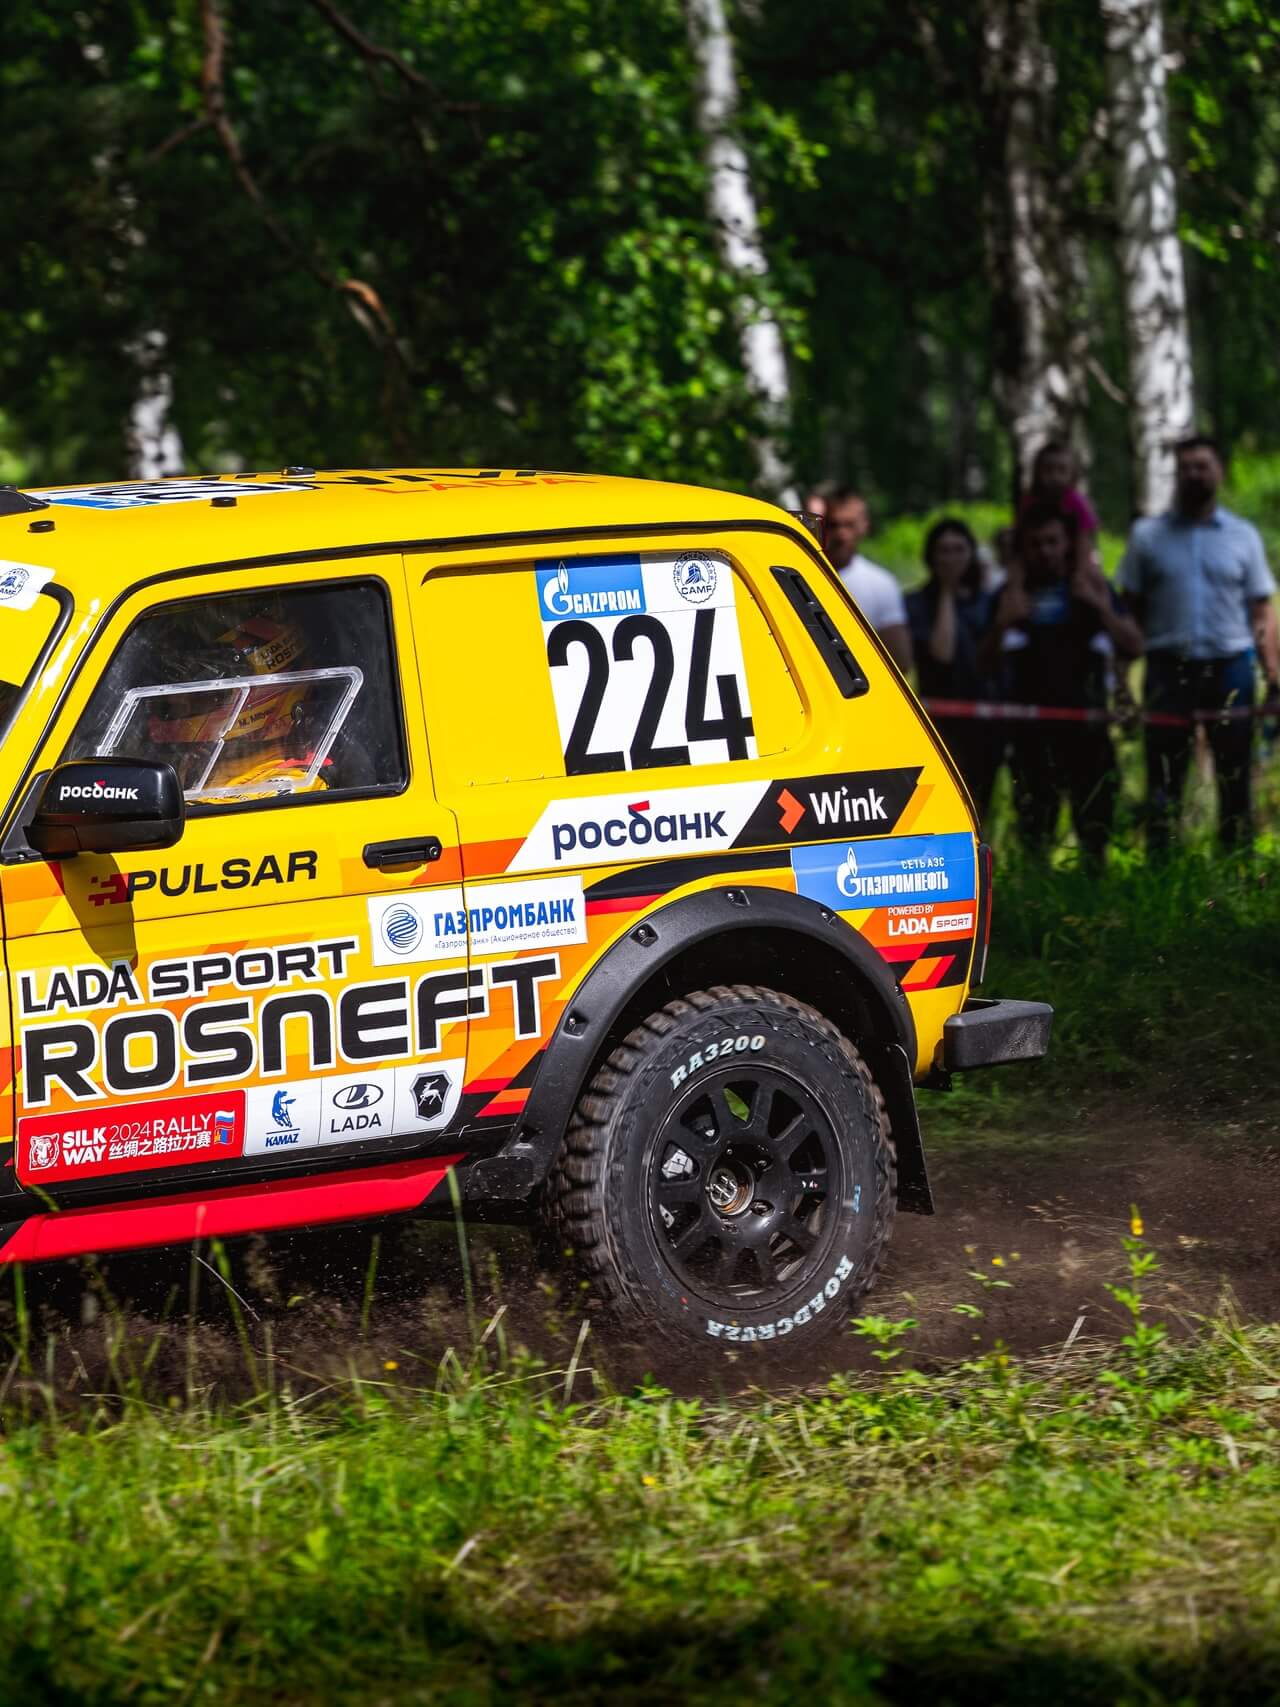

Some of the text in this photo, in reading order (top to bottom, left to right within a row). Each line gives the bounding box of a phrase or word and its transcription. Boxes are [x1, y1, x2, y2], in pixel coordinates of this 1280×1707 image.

[572, 589, 641, 614] GAZPROM
[681, 585, 712, 595] CAMF
[547, 608, 755, 777] 224
[60, 780, 139, 801] росбанк
[808, 785, 888, 825] Wink
[551, 800, 728, 860] росбанк
[126, 850, 318, 902] PULSAR
[901, 857, 945, 870] СЕТЬ АЗС
[861, 871, 949, 897] ГАЗПРОМНЕФТЬ
[434, 898, 575, 937] ГАЗПРОМБАНК
[888, 904, 935, 917] POWERED BY
[888, 917, 969, 936] LADA SPORT
[21, 940, 356, 1015] LADA SPORT
[24, 957, 558, 1103] ROSNEFT
[669, 1035, 766, 1090] RA3200
[62, 1113, 212, 1149] SILK 2024 RALLY
[330, 1113, 382, 1133] LADA
[108, 1131, 212, 1160] 丝绸之路拉力赛
[265, 1133, 300, 1147] KAMAZ
[63, 1145, 107, 1165] WAY
[705, 1254, 855, 1342] ROADCRUZA
